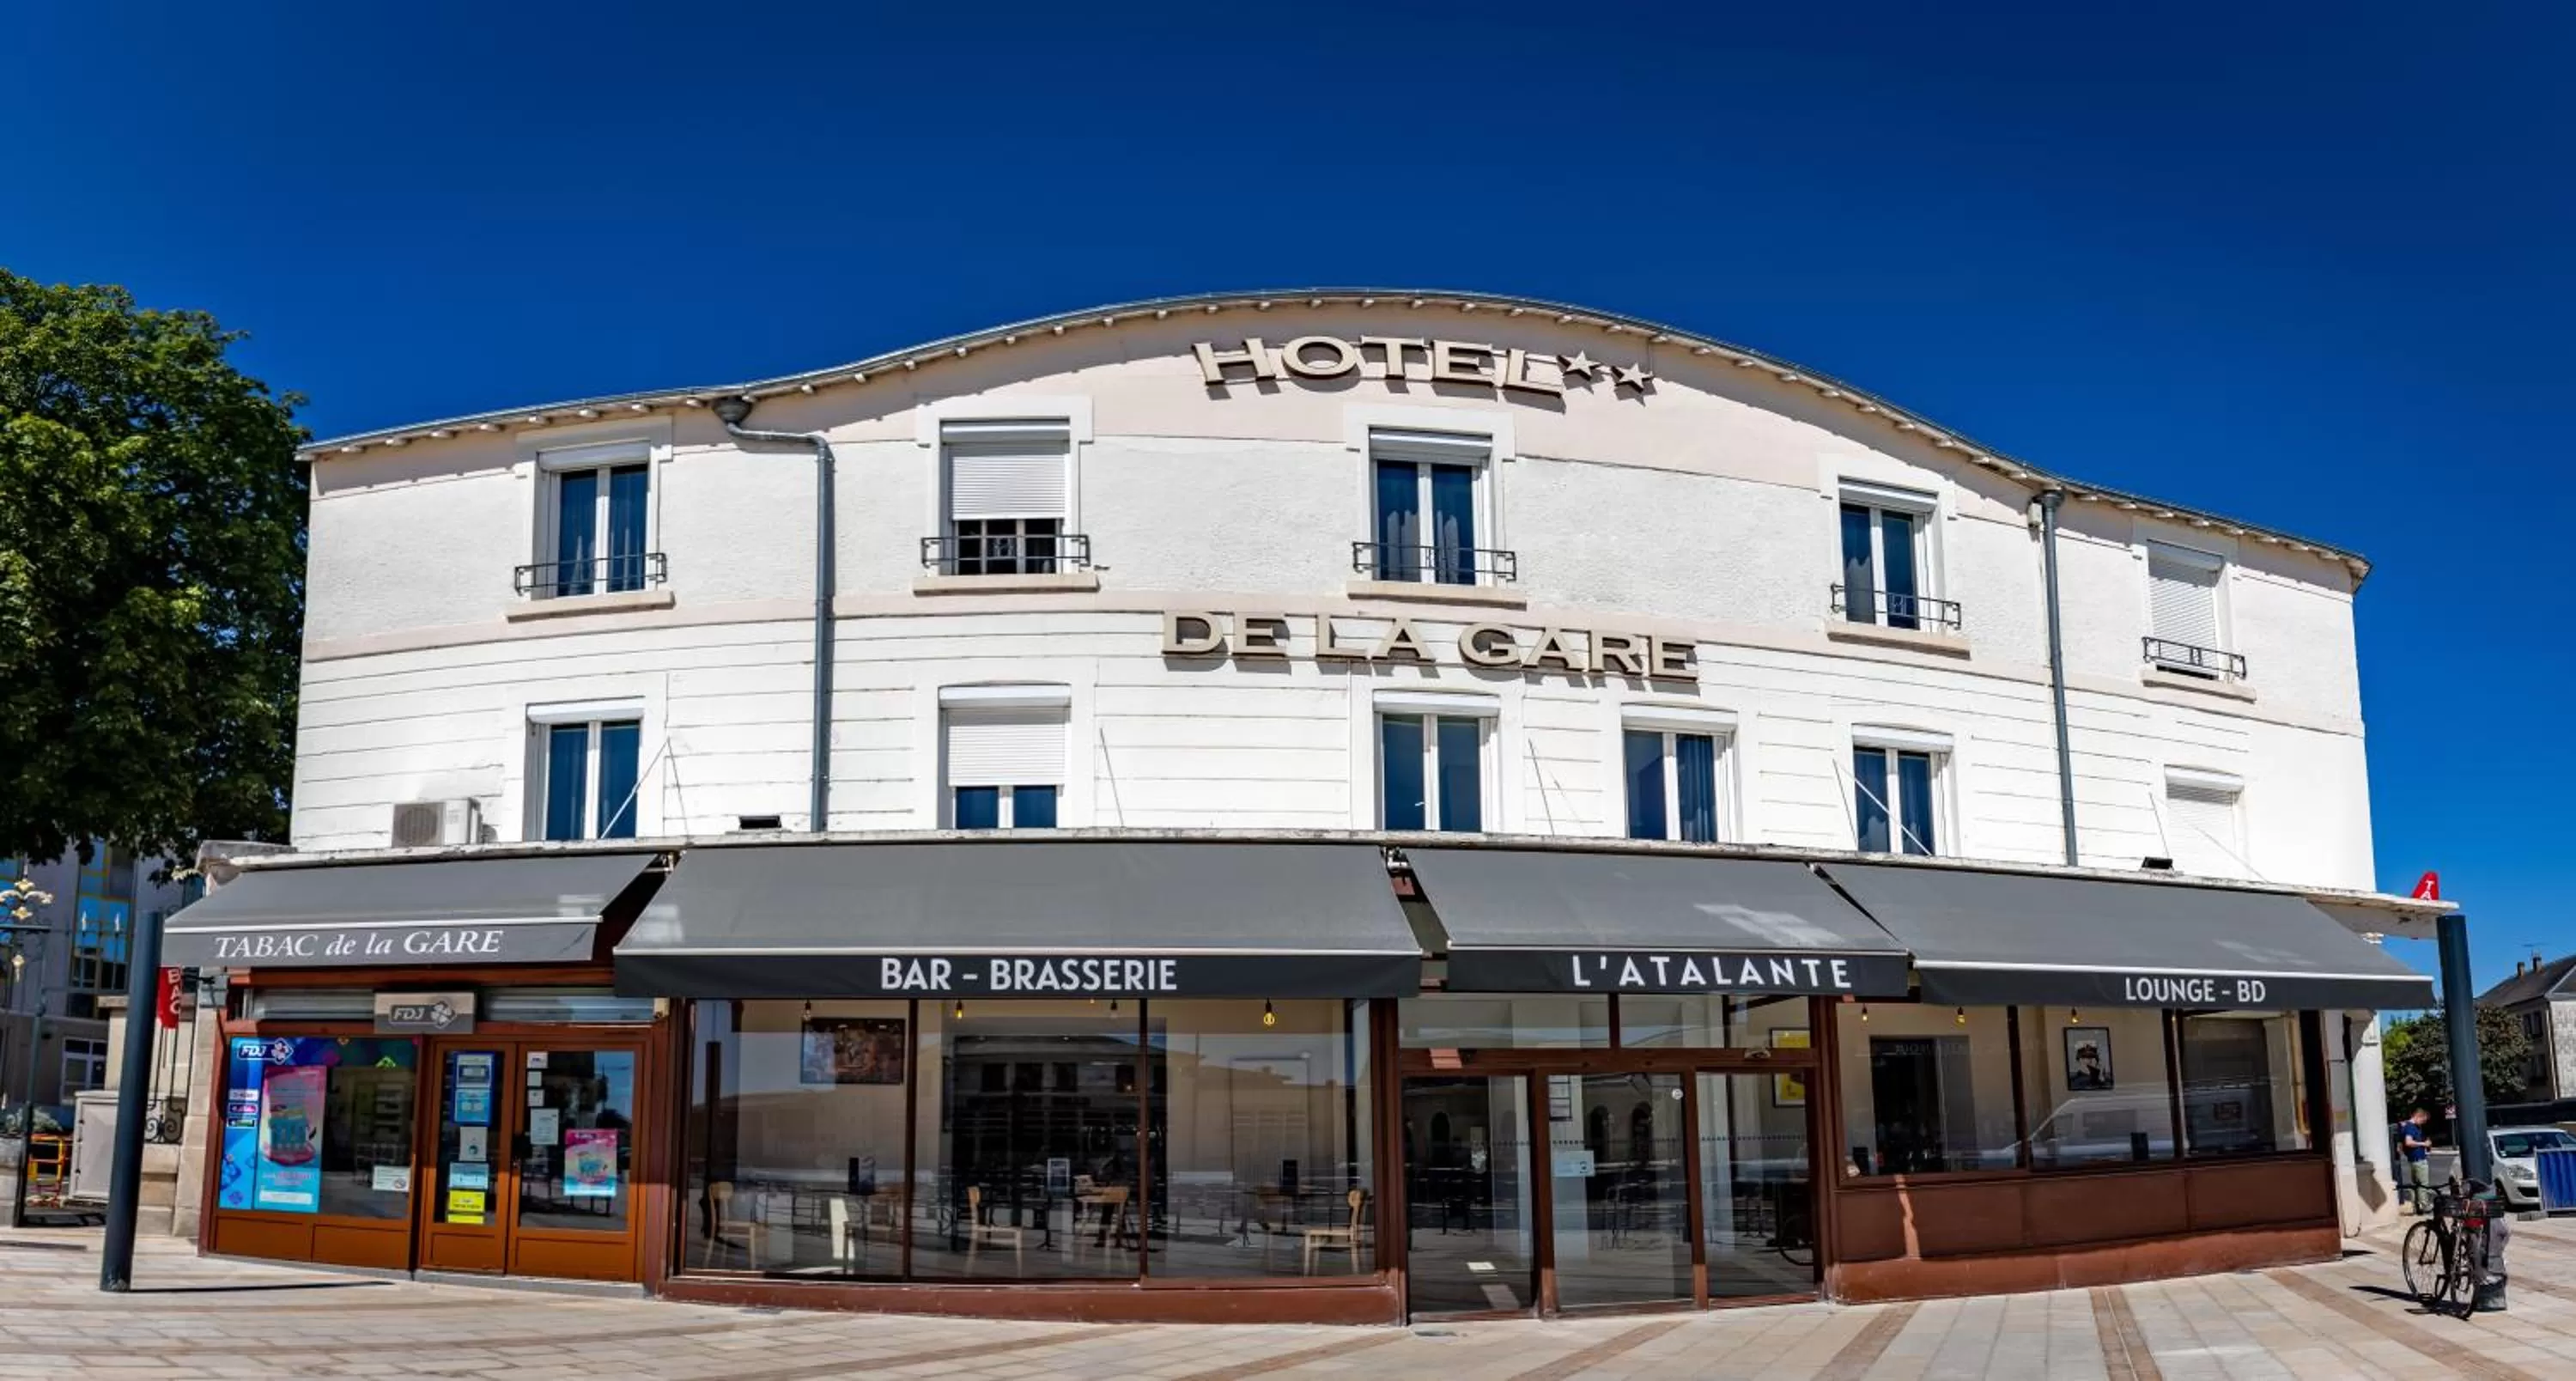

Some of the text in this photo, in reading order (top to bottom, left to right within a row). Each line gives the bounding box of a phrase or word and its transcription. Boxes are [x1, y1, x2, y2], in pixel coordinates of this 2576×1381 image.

[1192, 335, 1562, 396] HOTEL
[1162, 611, 1698, 682] DE LA GARE
[215, 930, 504, 958] TABAC de la GARE
[881, 958, 952, 989] BAR
[990, 958, 1177, 990] BRASSERIE
[1572, 955, 1851, 989] L'ATALANTE
[2125, 976, 2215, 1001] LOUNGE
[2237, 979, 2266, 1002] BD
[392, 1007, 424, 1021] FDJ
[240, 1045, 267, 1056] FDJ
